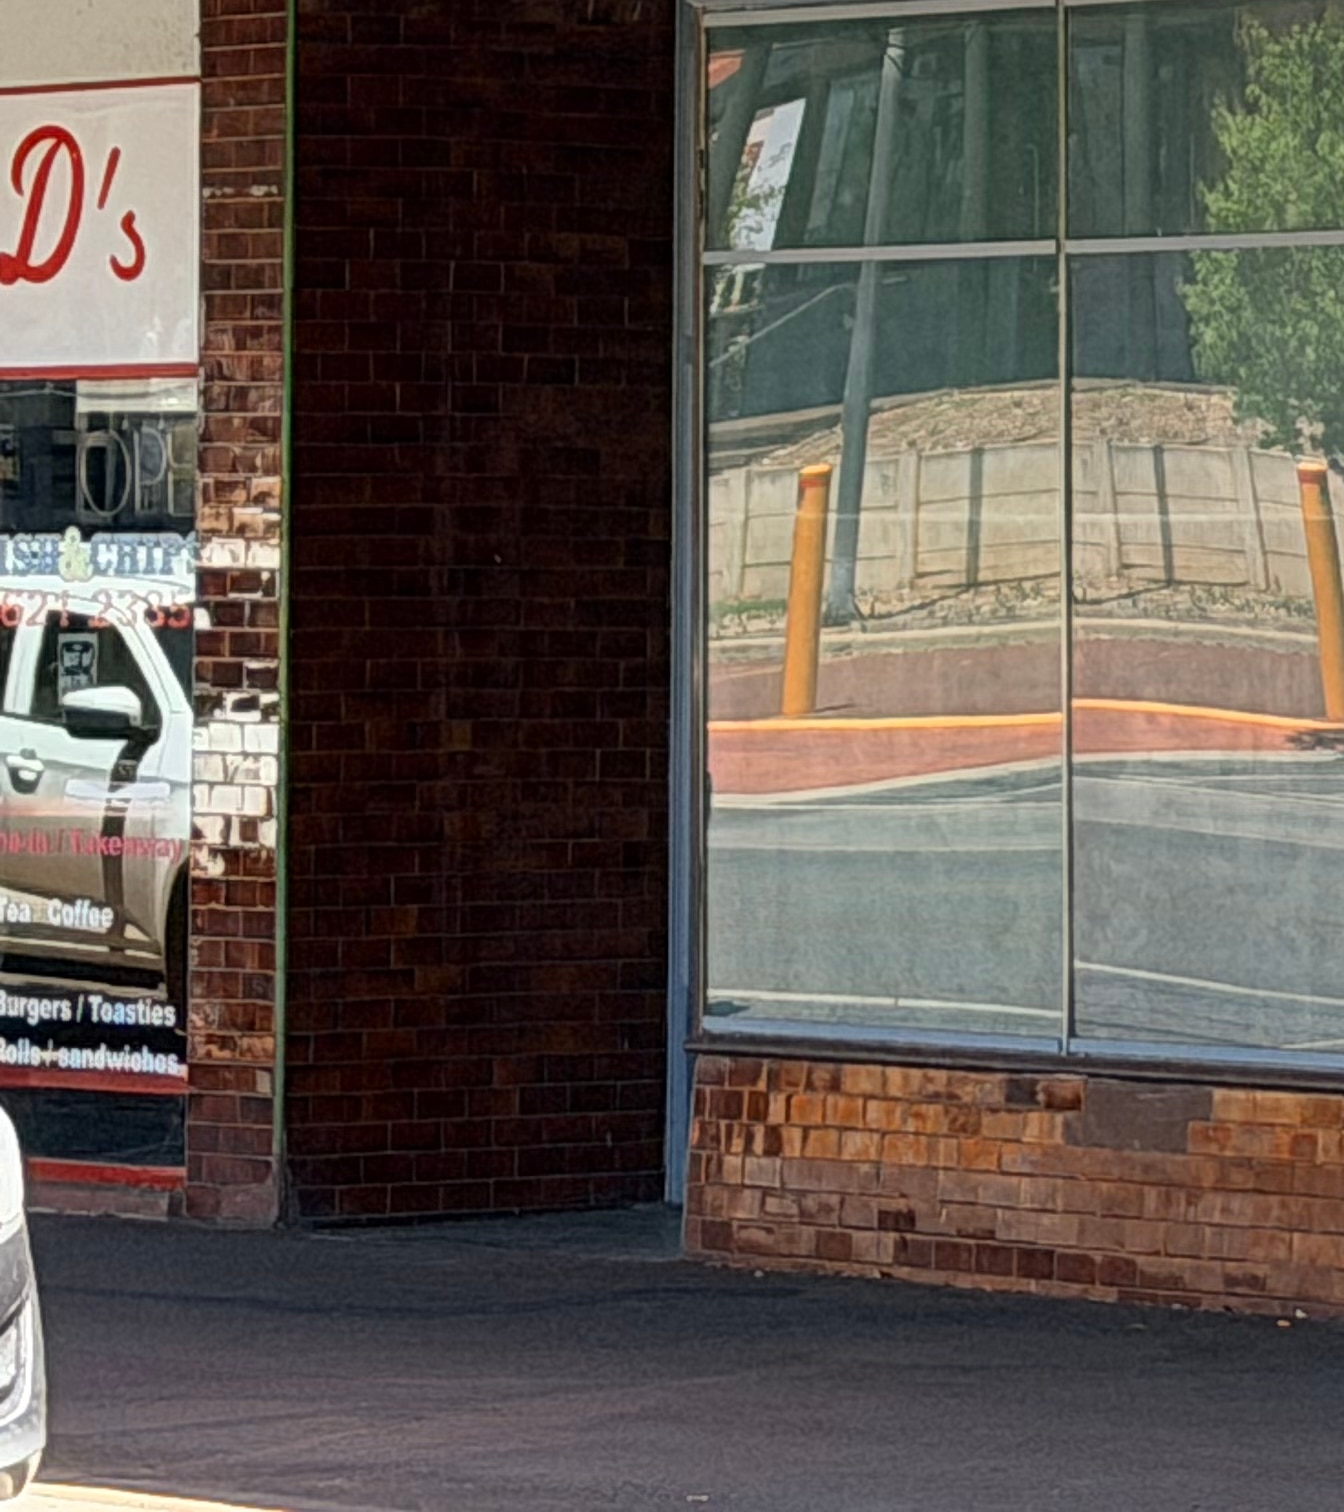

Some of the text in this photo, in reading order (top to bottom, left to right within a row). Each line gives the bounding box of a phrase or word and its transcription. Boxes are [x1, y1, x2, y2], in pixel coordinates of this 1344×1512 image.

[48, 897, 114, 928] Coffee
[88, 995, 177, 1027] Toasties
[58, 1043, 180, 1078] sandwiches
